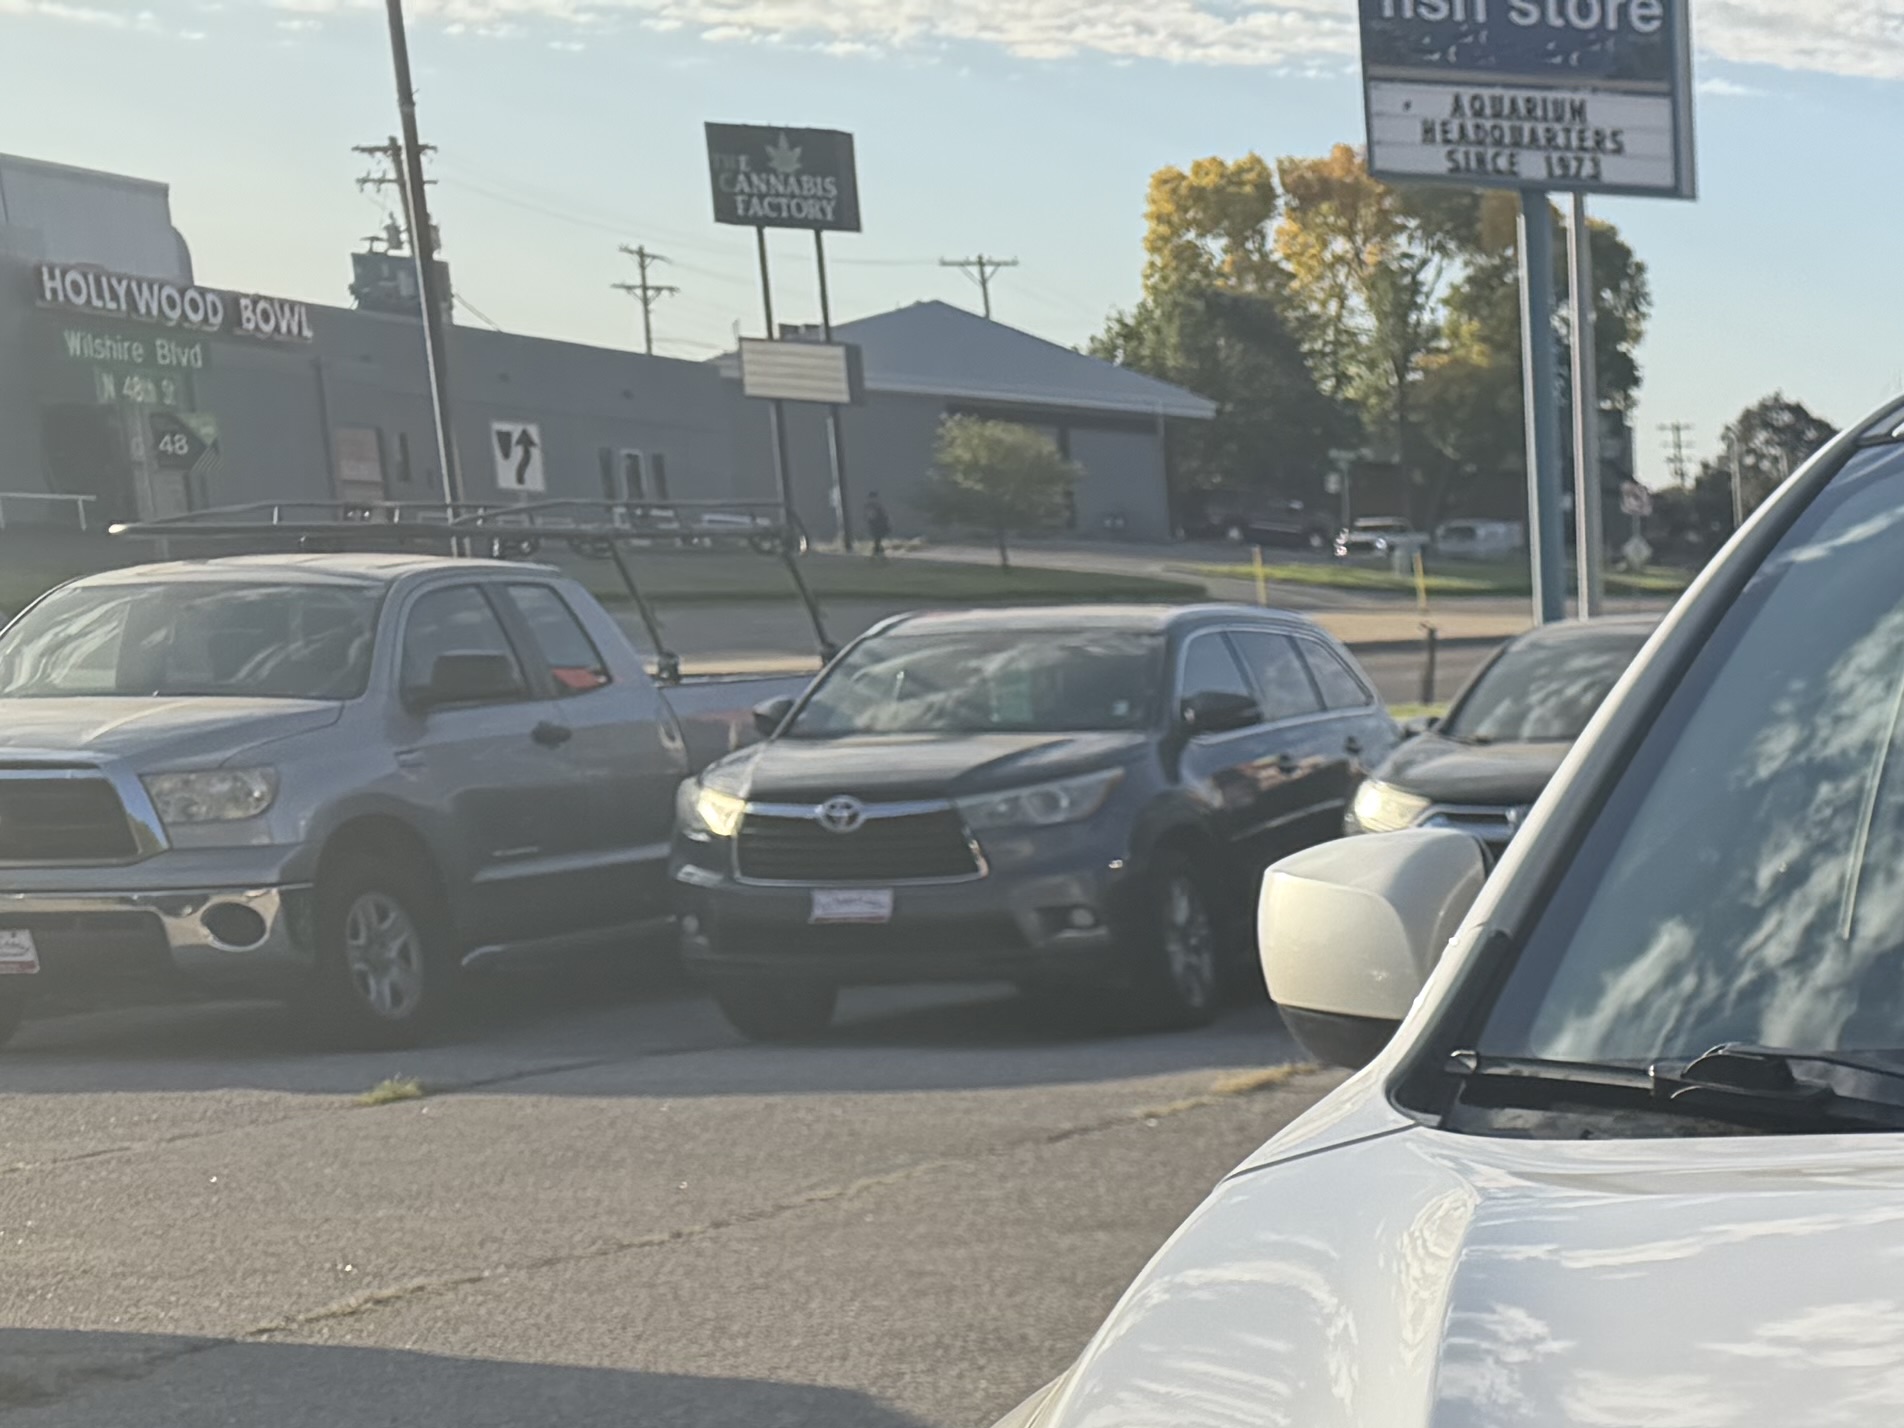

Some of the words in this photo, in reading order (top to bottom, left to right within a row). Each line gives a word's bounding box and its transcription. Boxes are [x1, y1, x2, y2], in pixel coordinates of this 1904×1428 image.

[1451, 93, 1588, 125] AQUARIUM
[1420, 119, 1625, 155] HEADQUARTERS
[1445, 149, 1520, 177] SINCE
[719, 172, 838, 198] CANNABIS
[734, 195, 837, 221] FACTORY
[41, 265, 225, 325] HOLLYWOOD
[238, 297, 314, 339] BOWL
[63, 328, 145, 363] Wilshire
[154, 338, 203, 369] Blvd
[158, 433, 189, 456] 48
